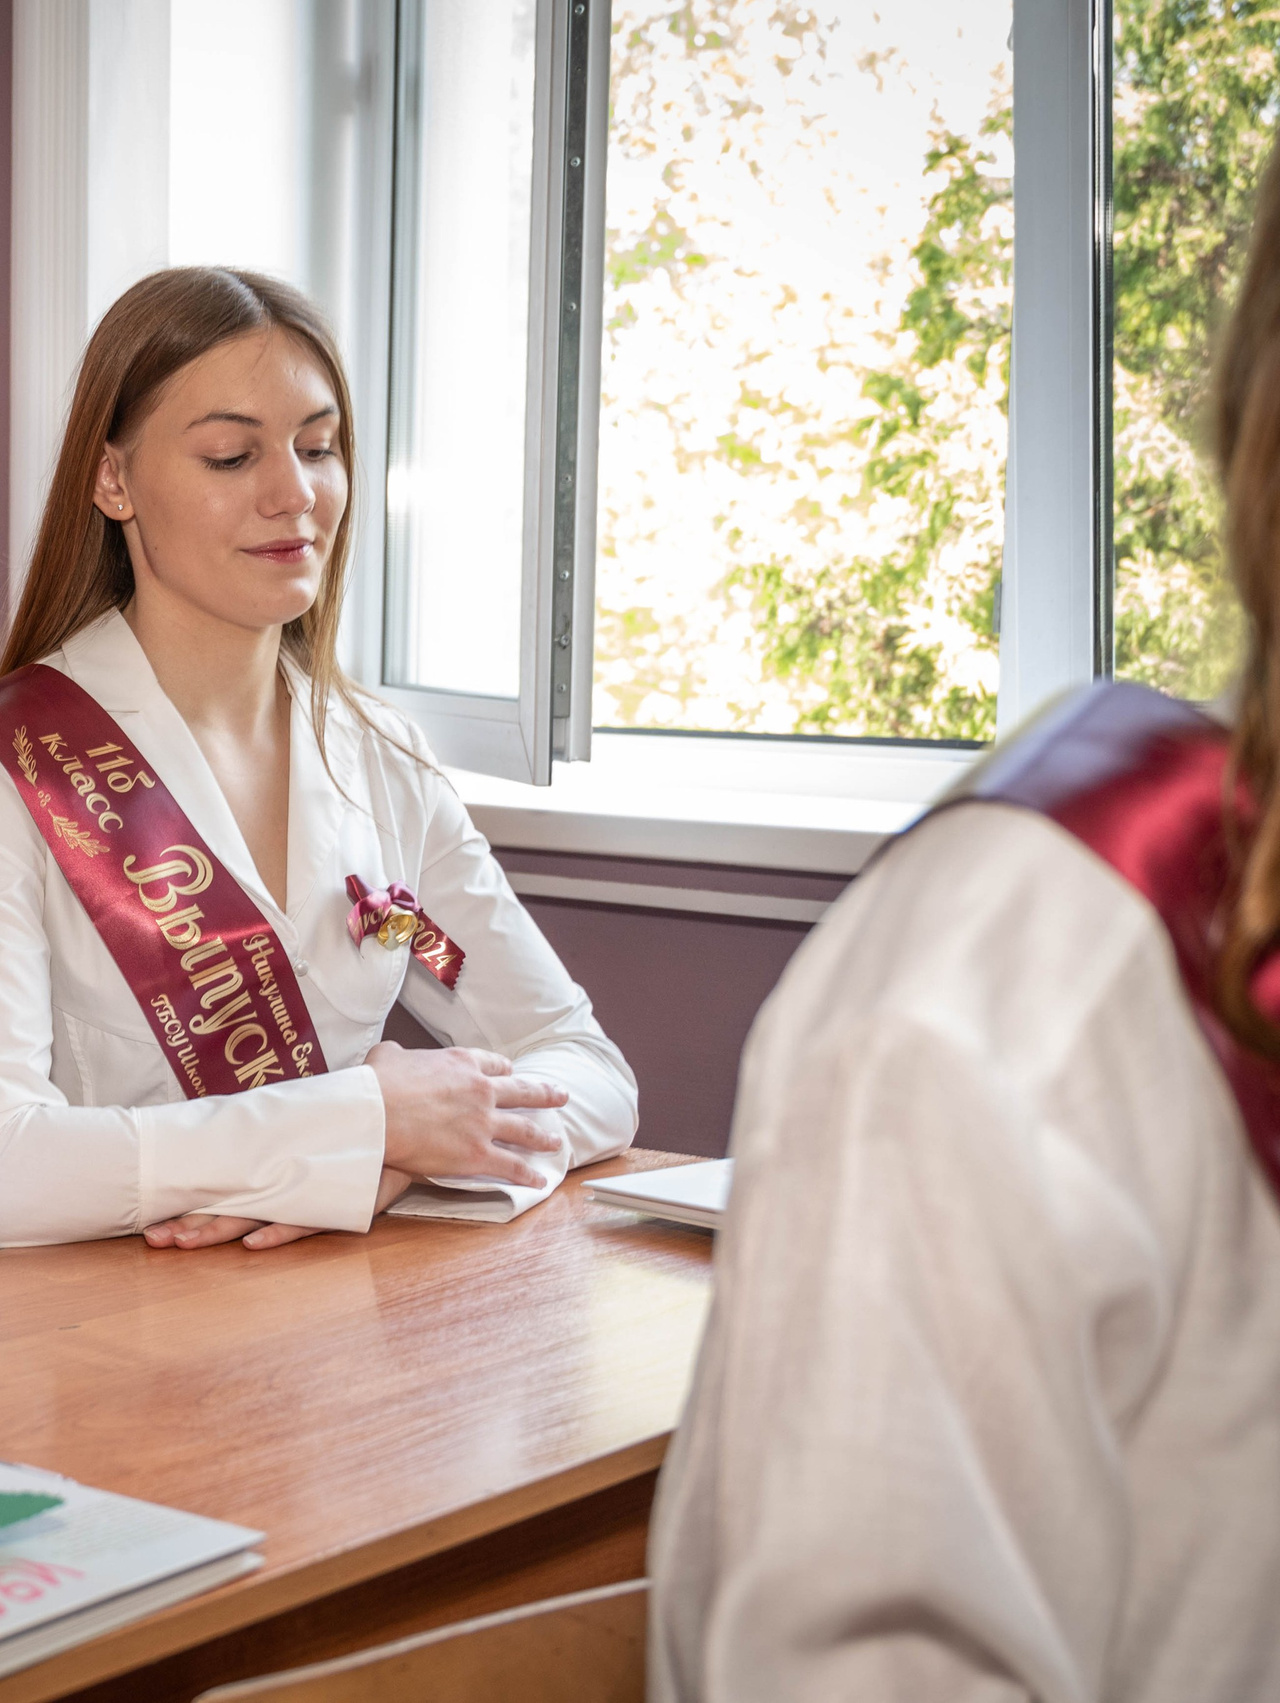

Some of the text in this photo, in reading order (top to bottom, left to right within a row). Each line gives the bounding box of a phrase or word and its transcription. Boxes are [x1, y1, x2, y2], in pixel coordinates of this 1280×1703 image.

[123, 844, 285, 1090] Выпуск
[242, 933, 298, 1046] Никулина
[150, 993, 207, 1098] ГБОУ Школ
